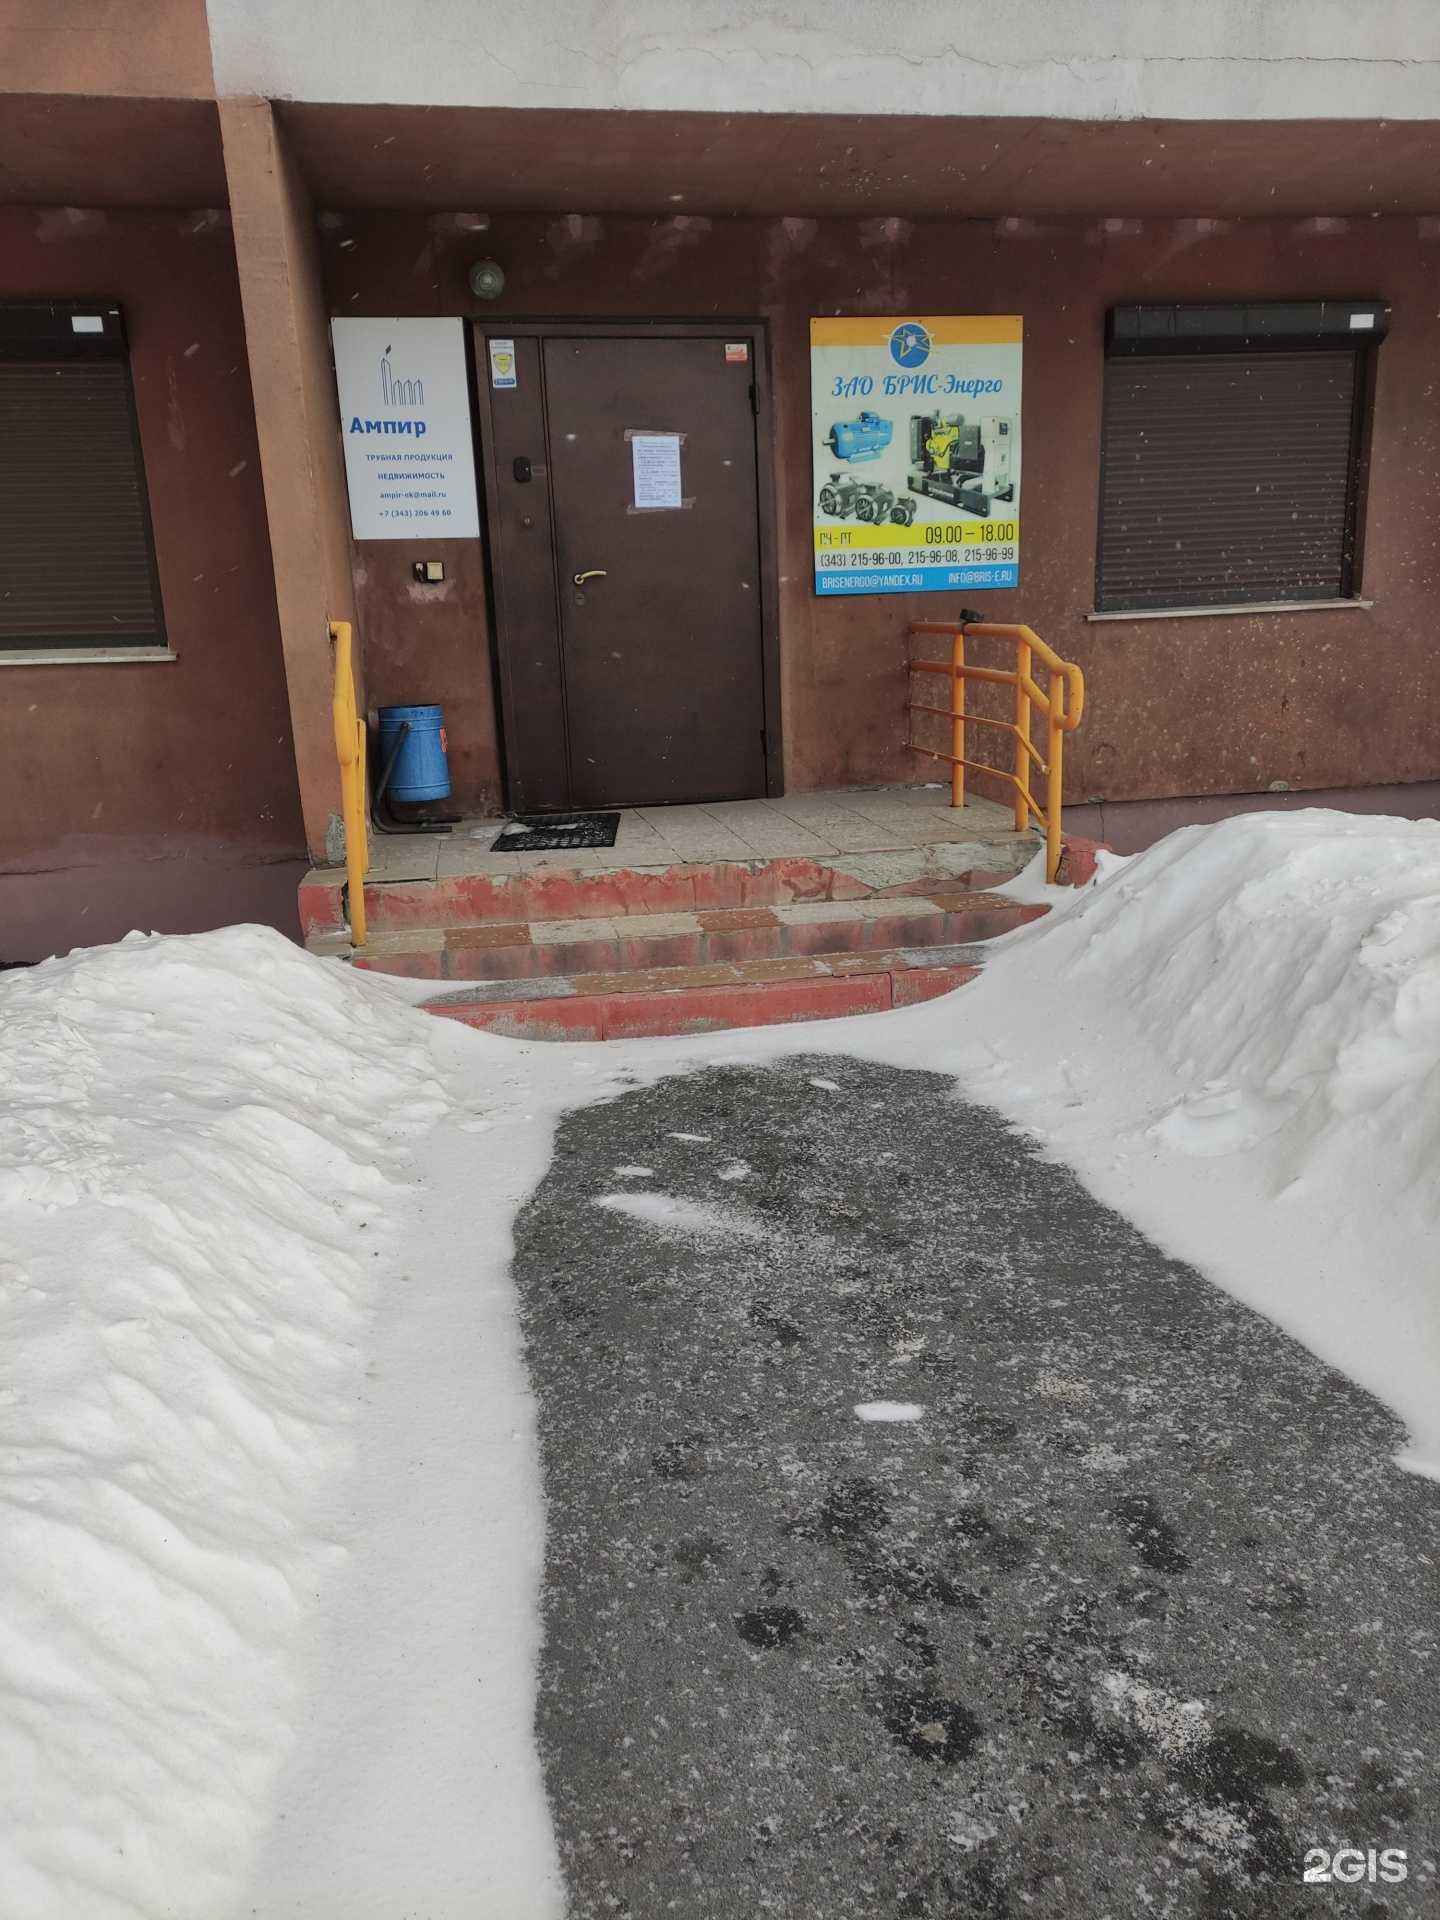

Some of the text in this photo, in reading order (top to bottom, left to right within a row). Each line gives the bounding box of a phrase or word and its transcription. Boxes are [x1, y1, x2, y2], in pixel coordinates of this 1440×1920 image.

[832, 374, 1003, 399] ЗАО БРИС-Энерго
[349, 416, 426, 438] Ампир
[366, 453, 453, 462] ТРУБНАЯ ПРОДУКЦИЯ
[377, 472, 445, 480] НЕДВИЖИМОСТЬ
[925, 525, 962, 544] 09.00
[980, 523, 1014, 542] 18.00
[820, 547, 1014, 567] (343) 215-96-00, 215-96-08, 215-96-99
